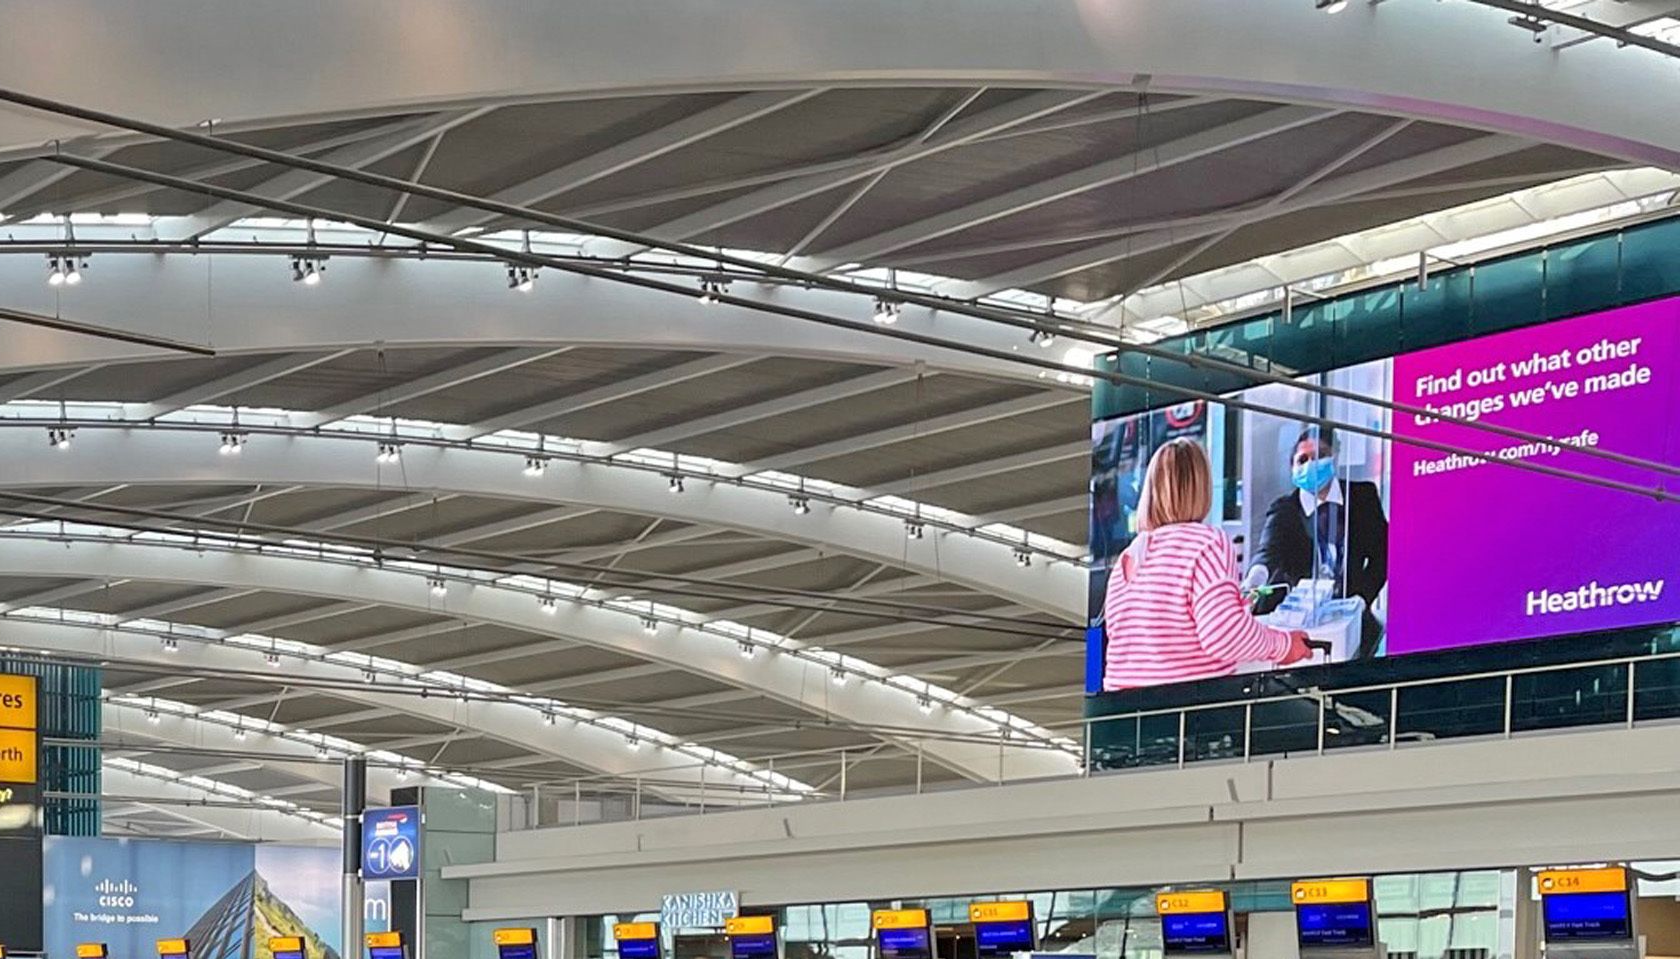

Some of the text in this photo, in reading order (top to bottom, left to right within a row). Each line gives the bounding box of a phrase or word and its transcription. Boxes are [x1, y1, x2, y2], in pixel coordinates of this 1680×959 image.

[1416, 338, 1642, 398] Find out what other
[1414, 394, 1504, 427] changes
[1584, 364, 1651, 394] made
[1526, 580, 1664, 616] Heathrow
[1558, 877, 1580, 887] C14
[99, 896, 134, 907] CISCO
[662, 891, 736, 911] KANISHKA
[74, 913, 159, 924] The bridge to possible
[661, 909, 722, 928] KITCHEN
